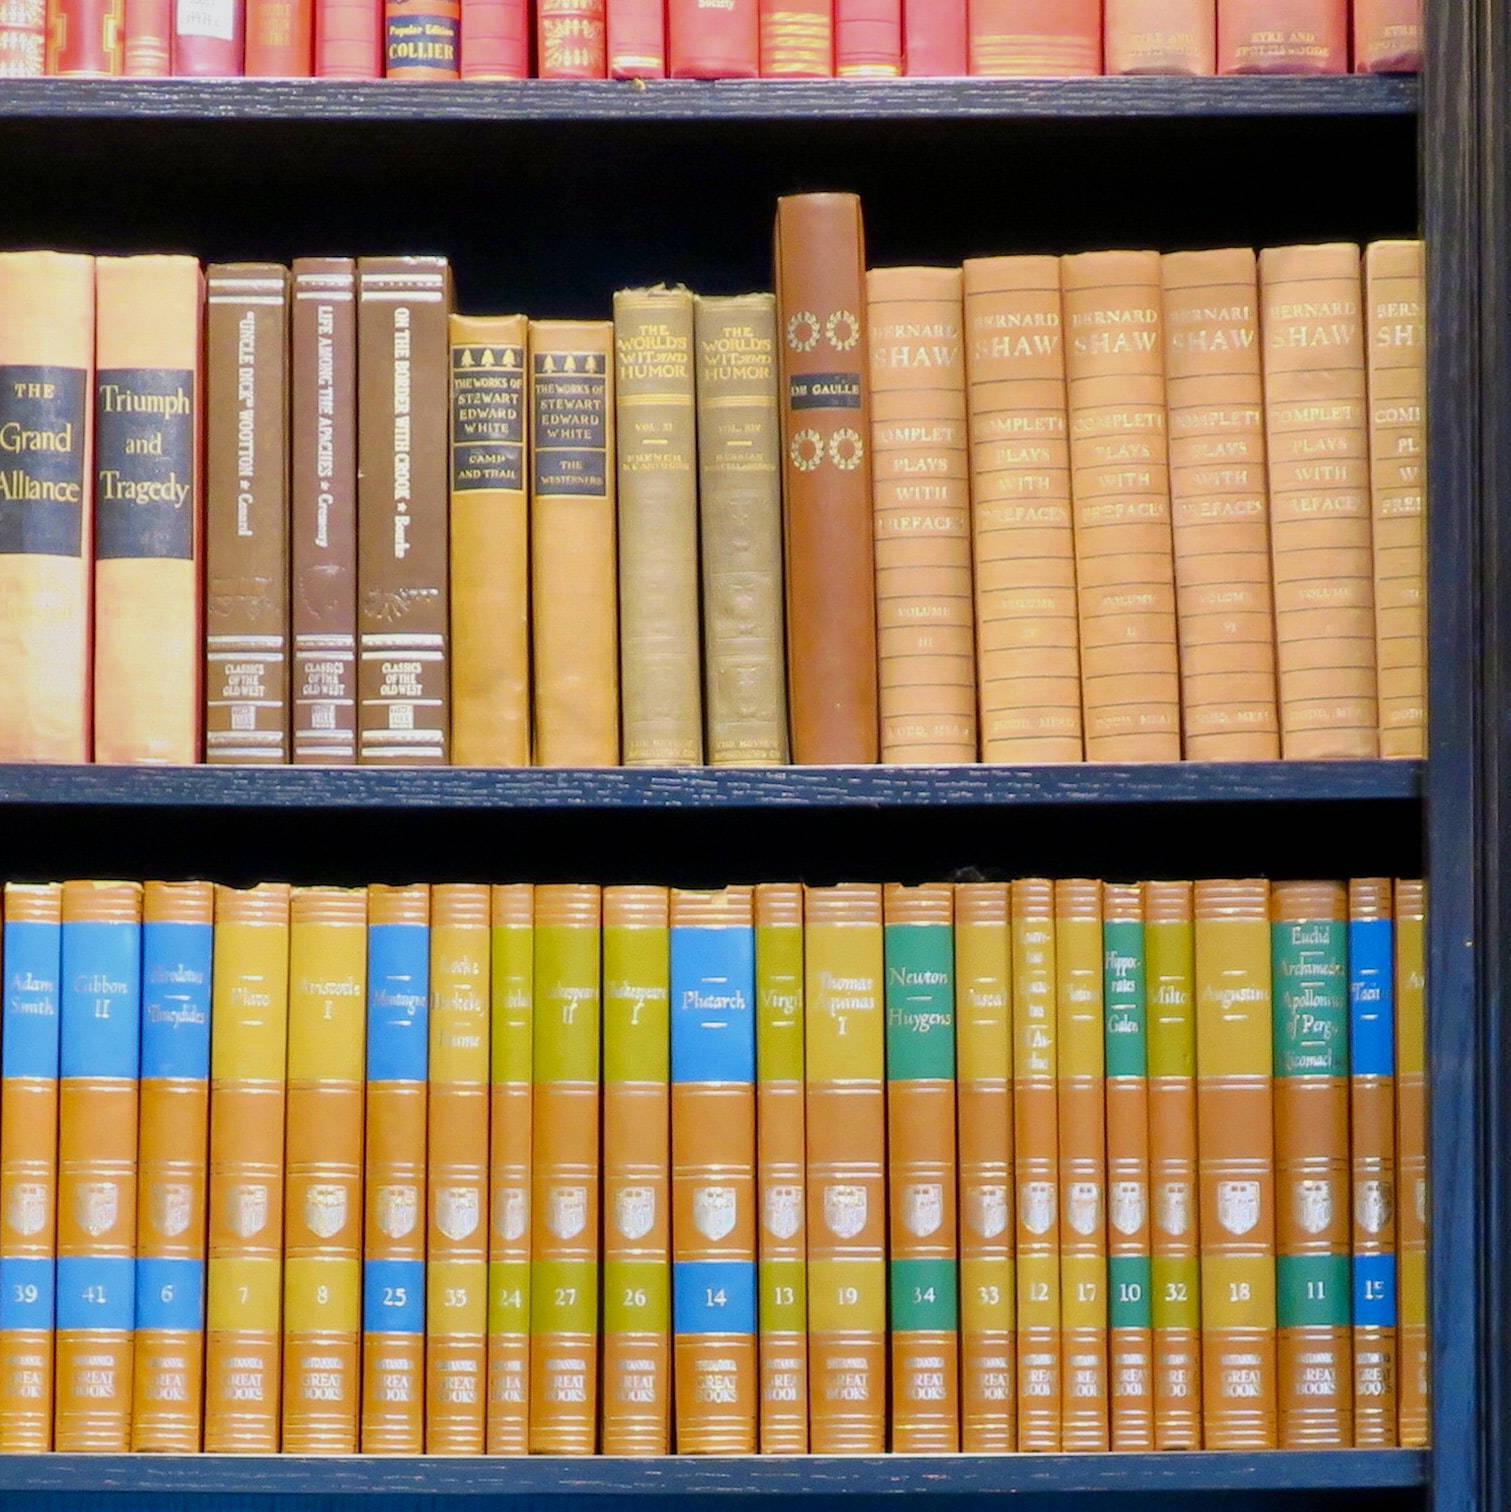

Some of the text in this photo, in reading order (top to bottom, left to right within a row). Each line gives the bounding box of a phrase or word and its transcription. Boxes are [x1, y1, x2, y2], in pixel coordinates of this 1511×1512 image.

[389, 24, 454, 37] Popular Edition
[389, 44, 454, 60] COLLIER
[15, 384, 55, 398] THE
[454, 377, 522, 388] THE WORKS OF
[791, 382, 859, 396] DE GAULLE
[318, 306, 333, 478] LIFE AMONG THE APACHES
[458, 393, 519, 405] STEWART
[101, 386, 189, 418] Triumph
[394, 308, 410, 500] ON THE BORDER WITH CROOK
[459, 408, 516, 420] EDWARD
[464, 423, 509, 434] WHITE
[0, 424, 72, 455] Grand
[125, 432, 162, 455] and
[239, 409, 254, 476] WOOTTON
[468, 453, 506, 464] CAMP
[458, 469, 515, 479] AND TRAIL
[100, 474, 189, 508] Tragedy
[382, 662, 422, 674] CLASSICS
[386, 674, 416, 684] OF THE
[380, 685, 423, 695] OLD WEST
[888, 967, 949, 988] Newton
[681, 991, 746, 1012] Plutarch
[888, 1006, 952, 1031] Huygens
[82, 1284, 107, 1303] 41
[554, 1286, 576, 1306] 27
[622, 1286, 646, 1306] 26
[706, 1288, 726, 1306] 14
[837, 1285, 857, 1304] 19
